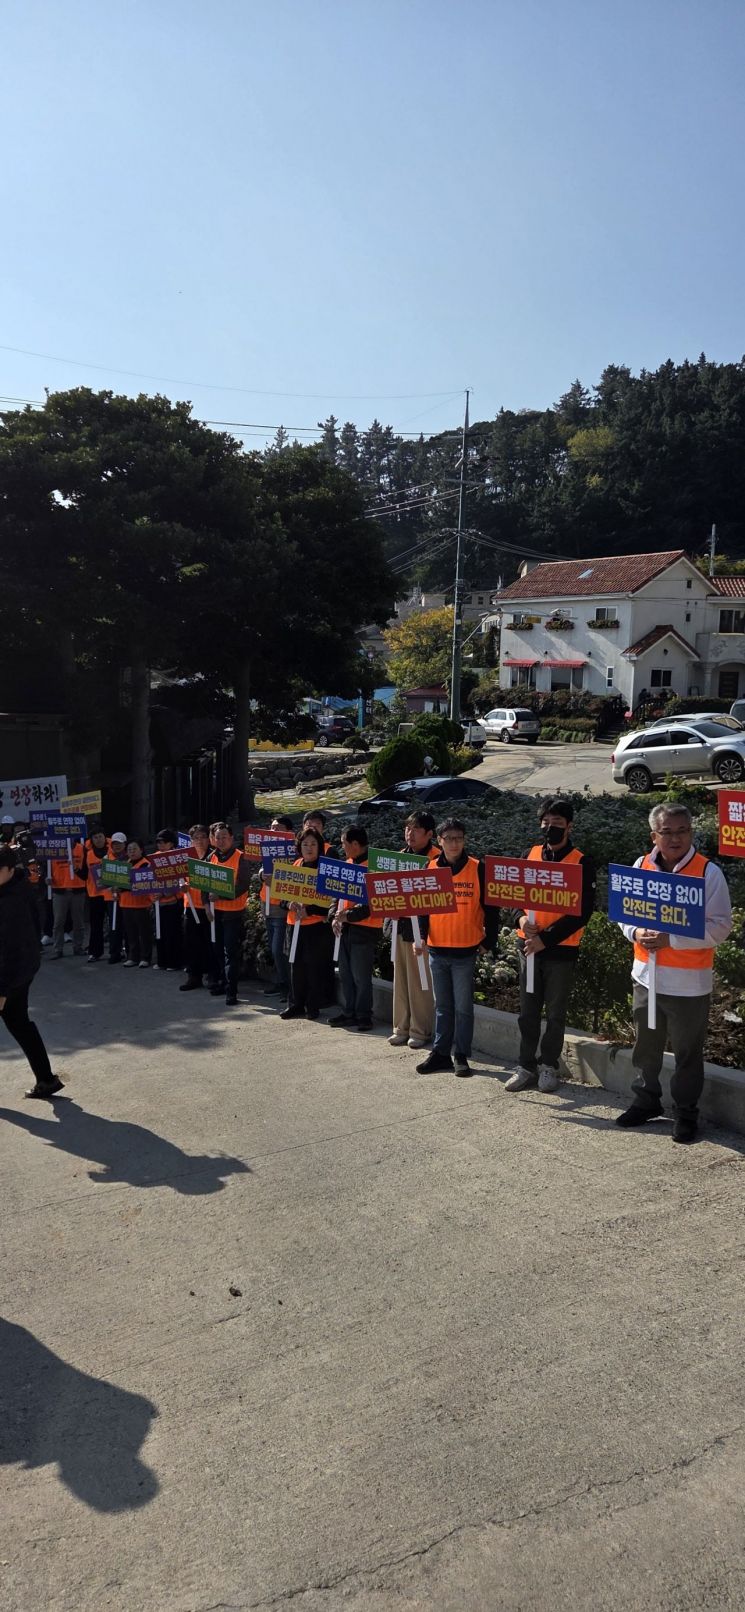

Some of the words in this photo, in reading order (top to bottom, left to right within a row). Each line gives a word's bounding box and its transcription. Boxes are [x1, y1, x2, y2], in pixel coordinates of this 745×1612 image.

[11, 784, 59, 807] 연장하라!
[728, 801, 745, 822] 짧
[244, 844, 262, 857] 안전
[261, 845, 286, 857] 활주로
[319, 863, 340, 878] 활주로
[341, 868, 356, 882] 연장
[376, 856, 398, 871] 생명줄
[373, 879, 398, 895] 짧은
[402, 876, 442, 893] 활주로,
[494, 864, 520, 883] 짧은
[523, 867, 568, 889] 활주로,
[325, 878, 347, 894] 안전도
[347, 883, 364, 899] 없다.
[487, 881, 525, 902] 안전은
[530, 887, 579, 907] 어디에?
[611, 873, 644, 896] 활주로
[647, 880, 672, 902] 연장
[676, 884, 703, 907] 없이
[371, 895, 407, 912] 안전은
[410, 892, 453, 909] 어디에?
[622, 896, 657, 921] 안전도
[660, 904, 691, 927] 없다.
